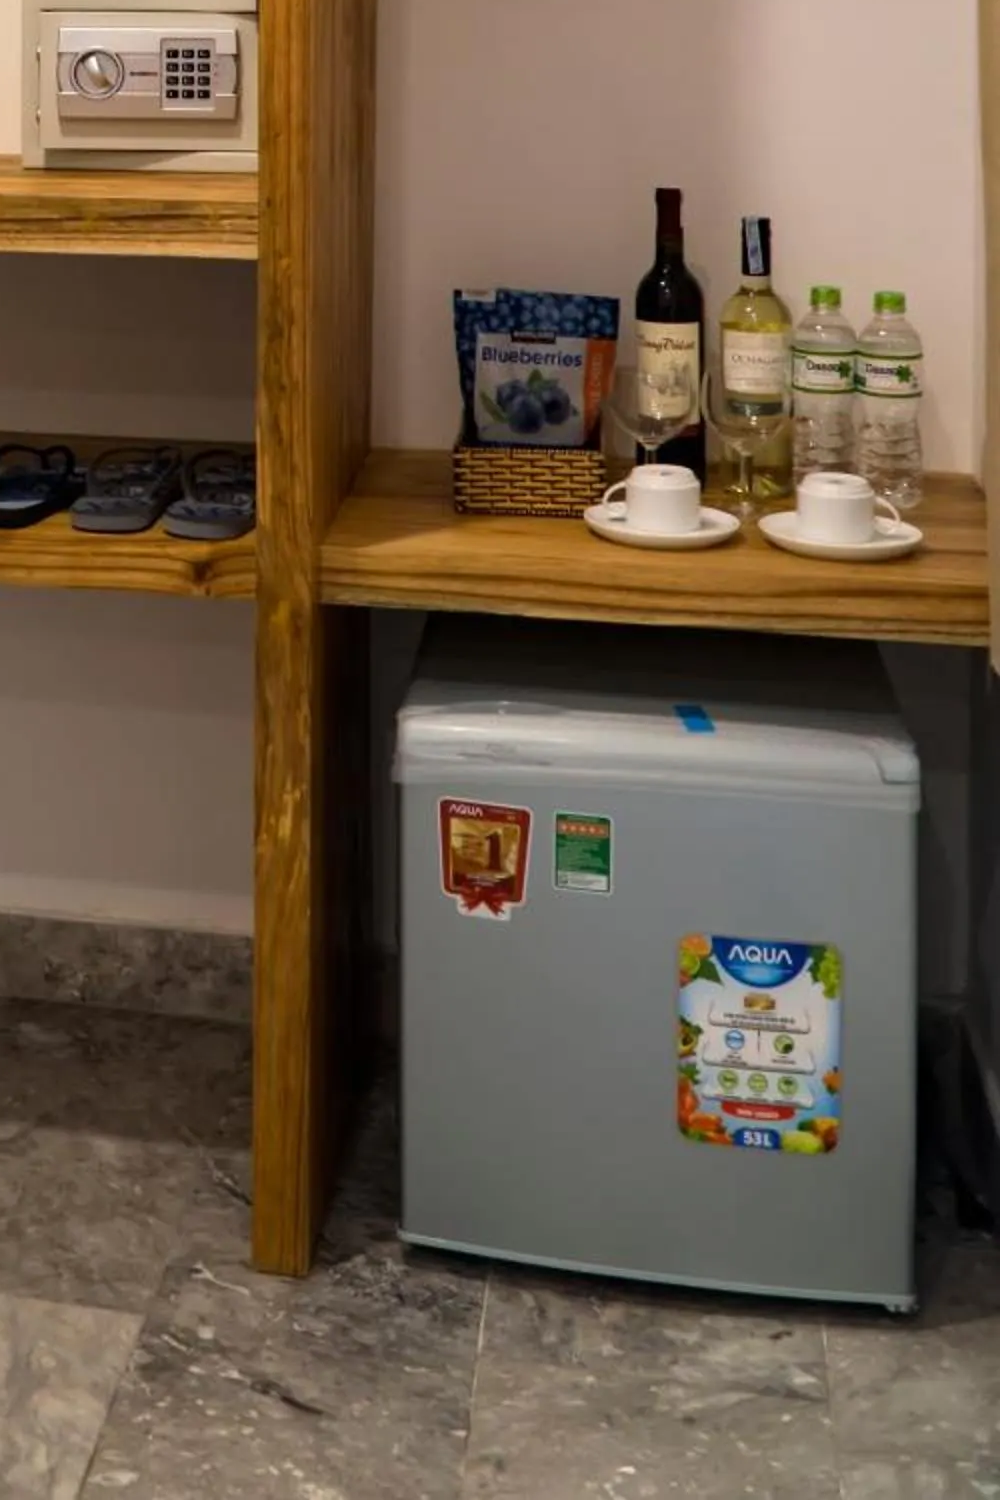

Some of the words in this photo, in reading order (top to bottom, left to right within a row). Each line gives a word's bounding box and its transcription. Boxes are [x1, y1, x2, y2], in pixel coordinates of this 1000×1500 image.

[481, 346, 583, 367] Blueberries
[449, 803, 484, 817] AQUA
[728, 944, 793, 965] AQUA
